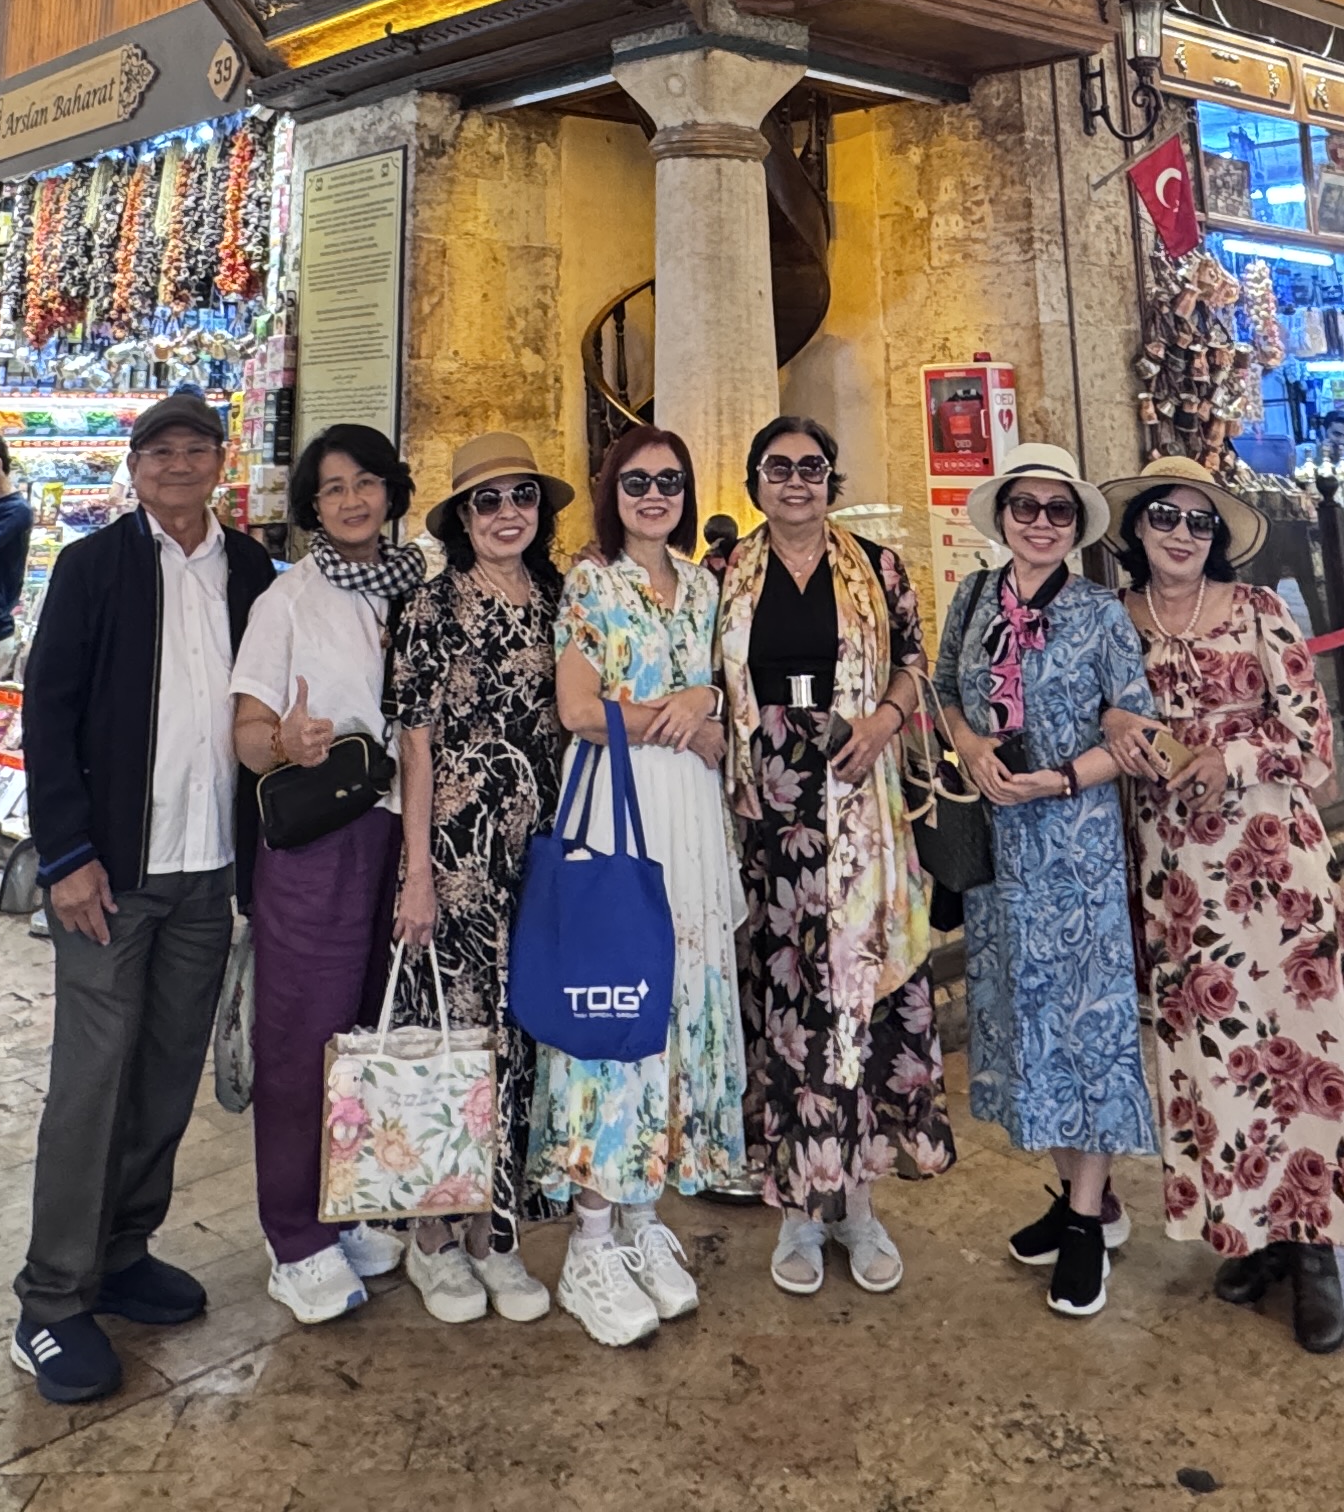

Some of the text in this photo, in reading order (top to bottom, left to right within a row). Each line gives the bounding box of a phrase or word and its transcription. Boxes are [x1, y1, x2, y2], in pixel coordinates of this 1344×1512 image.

[213, 55, 233, 86] 39
[1, 76, 116, 139] Arslan Baharat
[563, 986, 640, 1011] TOG
